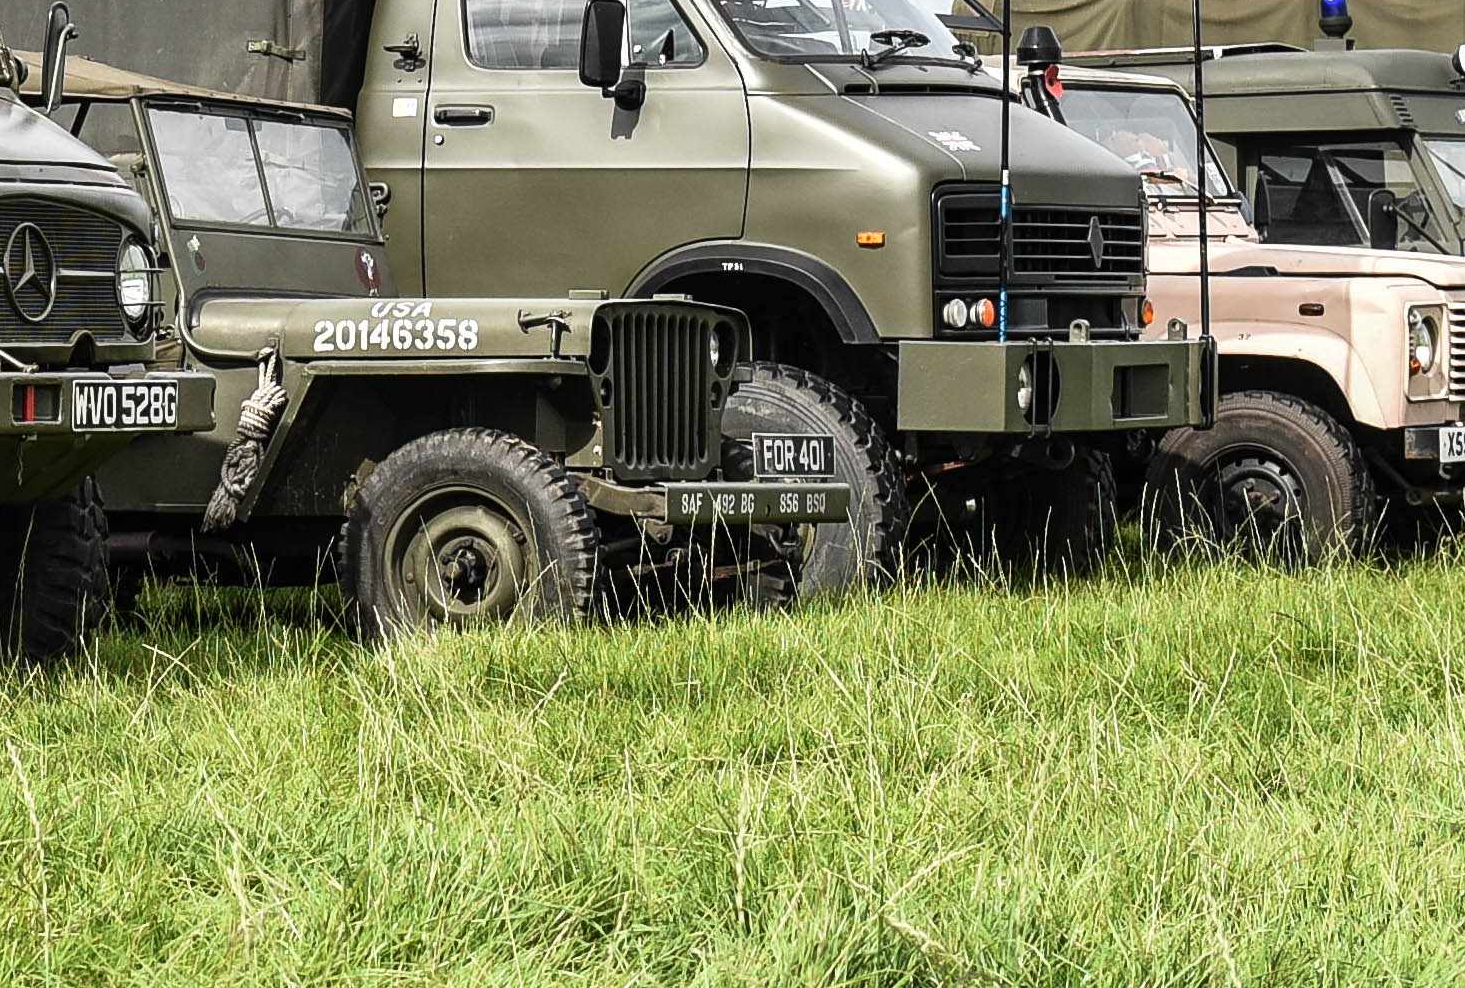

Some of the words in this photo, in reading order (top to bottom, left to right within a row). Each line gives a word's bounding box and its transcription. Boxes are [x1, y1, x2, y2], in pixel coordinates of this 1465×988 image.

[371, 301, 434, 318] USA
[313, 318, 479, 352] 20146358
[75, 386, 117, 425] WVO
[121, 386, 176, 424] 528G
[763, 439, 795, 472] FOR
[799, 439, 825, 472] 401
[741, 493, 755, 514] BG
[779, 493, 799, 513] 856
[806, 493, 826, 514] BSQ
